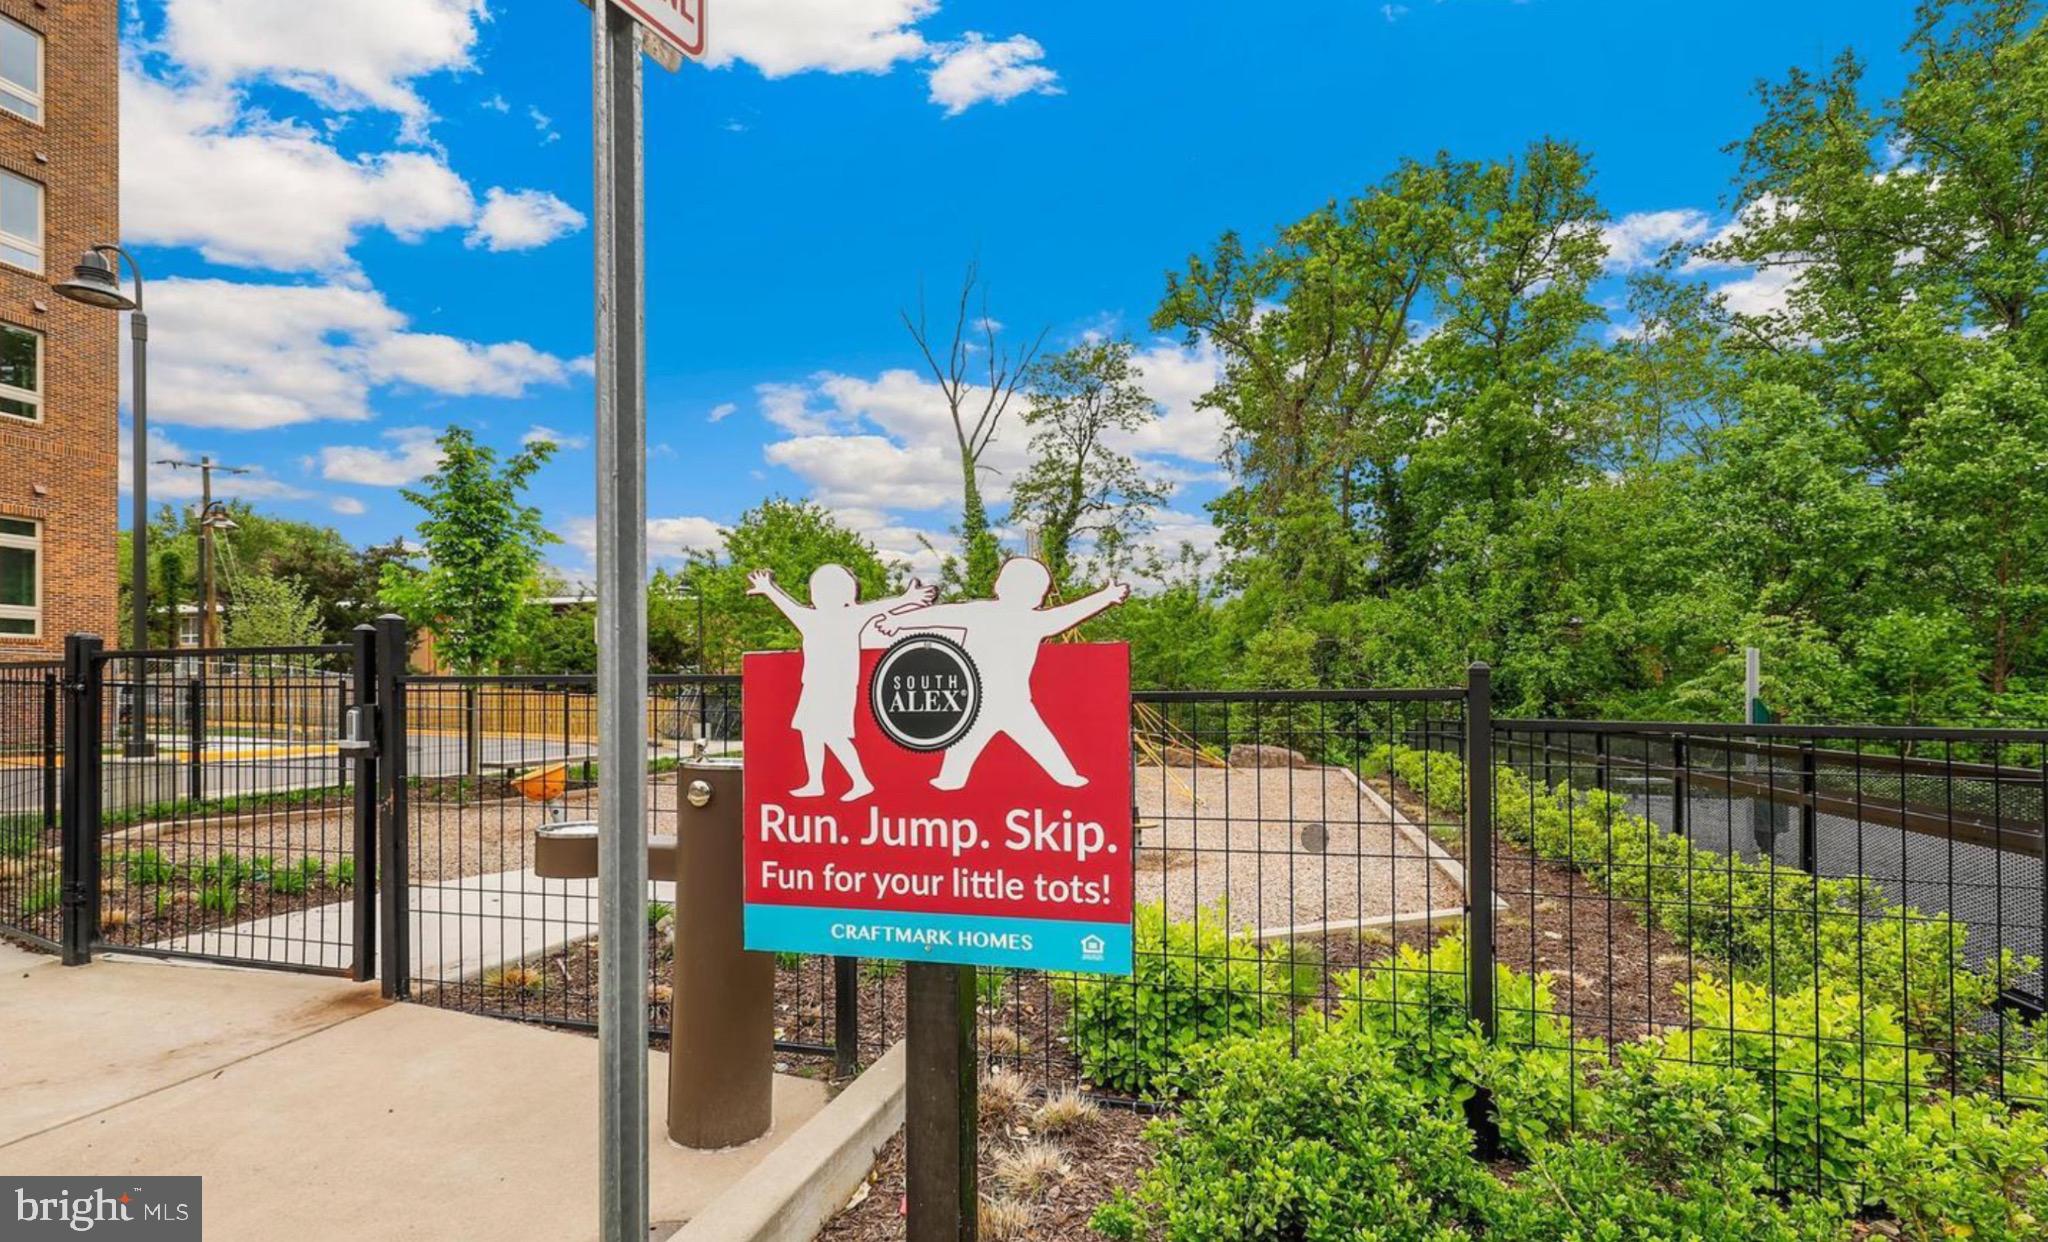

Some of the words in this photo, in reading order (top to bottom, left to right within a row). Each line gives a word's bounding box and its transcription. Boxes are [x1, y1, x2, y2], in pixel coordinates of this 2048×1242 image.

[893, 675, 958, 690] SOUTH
[760, 803, 849, 845] Run.
[860, 806, 990, 857] Jump.
[1005, 808, 1117, 862] Skip.
[761, 861, 814, 890] Fun
[822, 863, 866, 892] for
[873, 872, 944, 899] your
[952, 867, 1024, 899] little
[1034, 874, 1111, 905] tots!
[830, 923, 953, 946] CRAFTMARK
[958, 931, 1033, 950] HOMES
